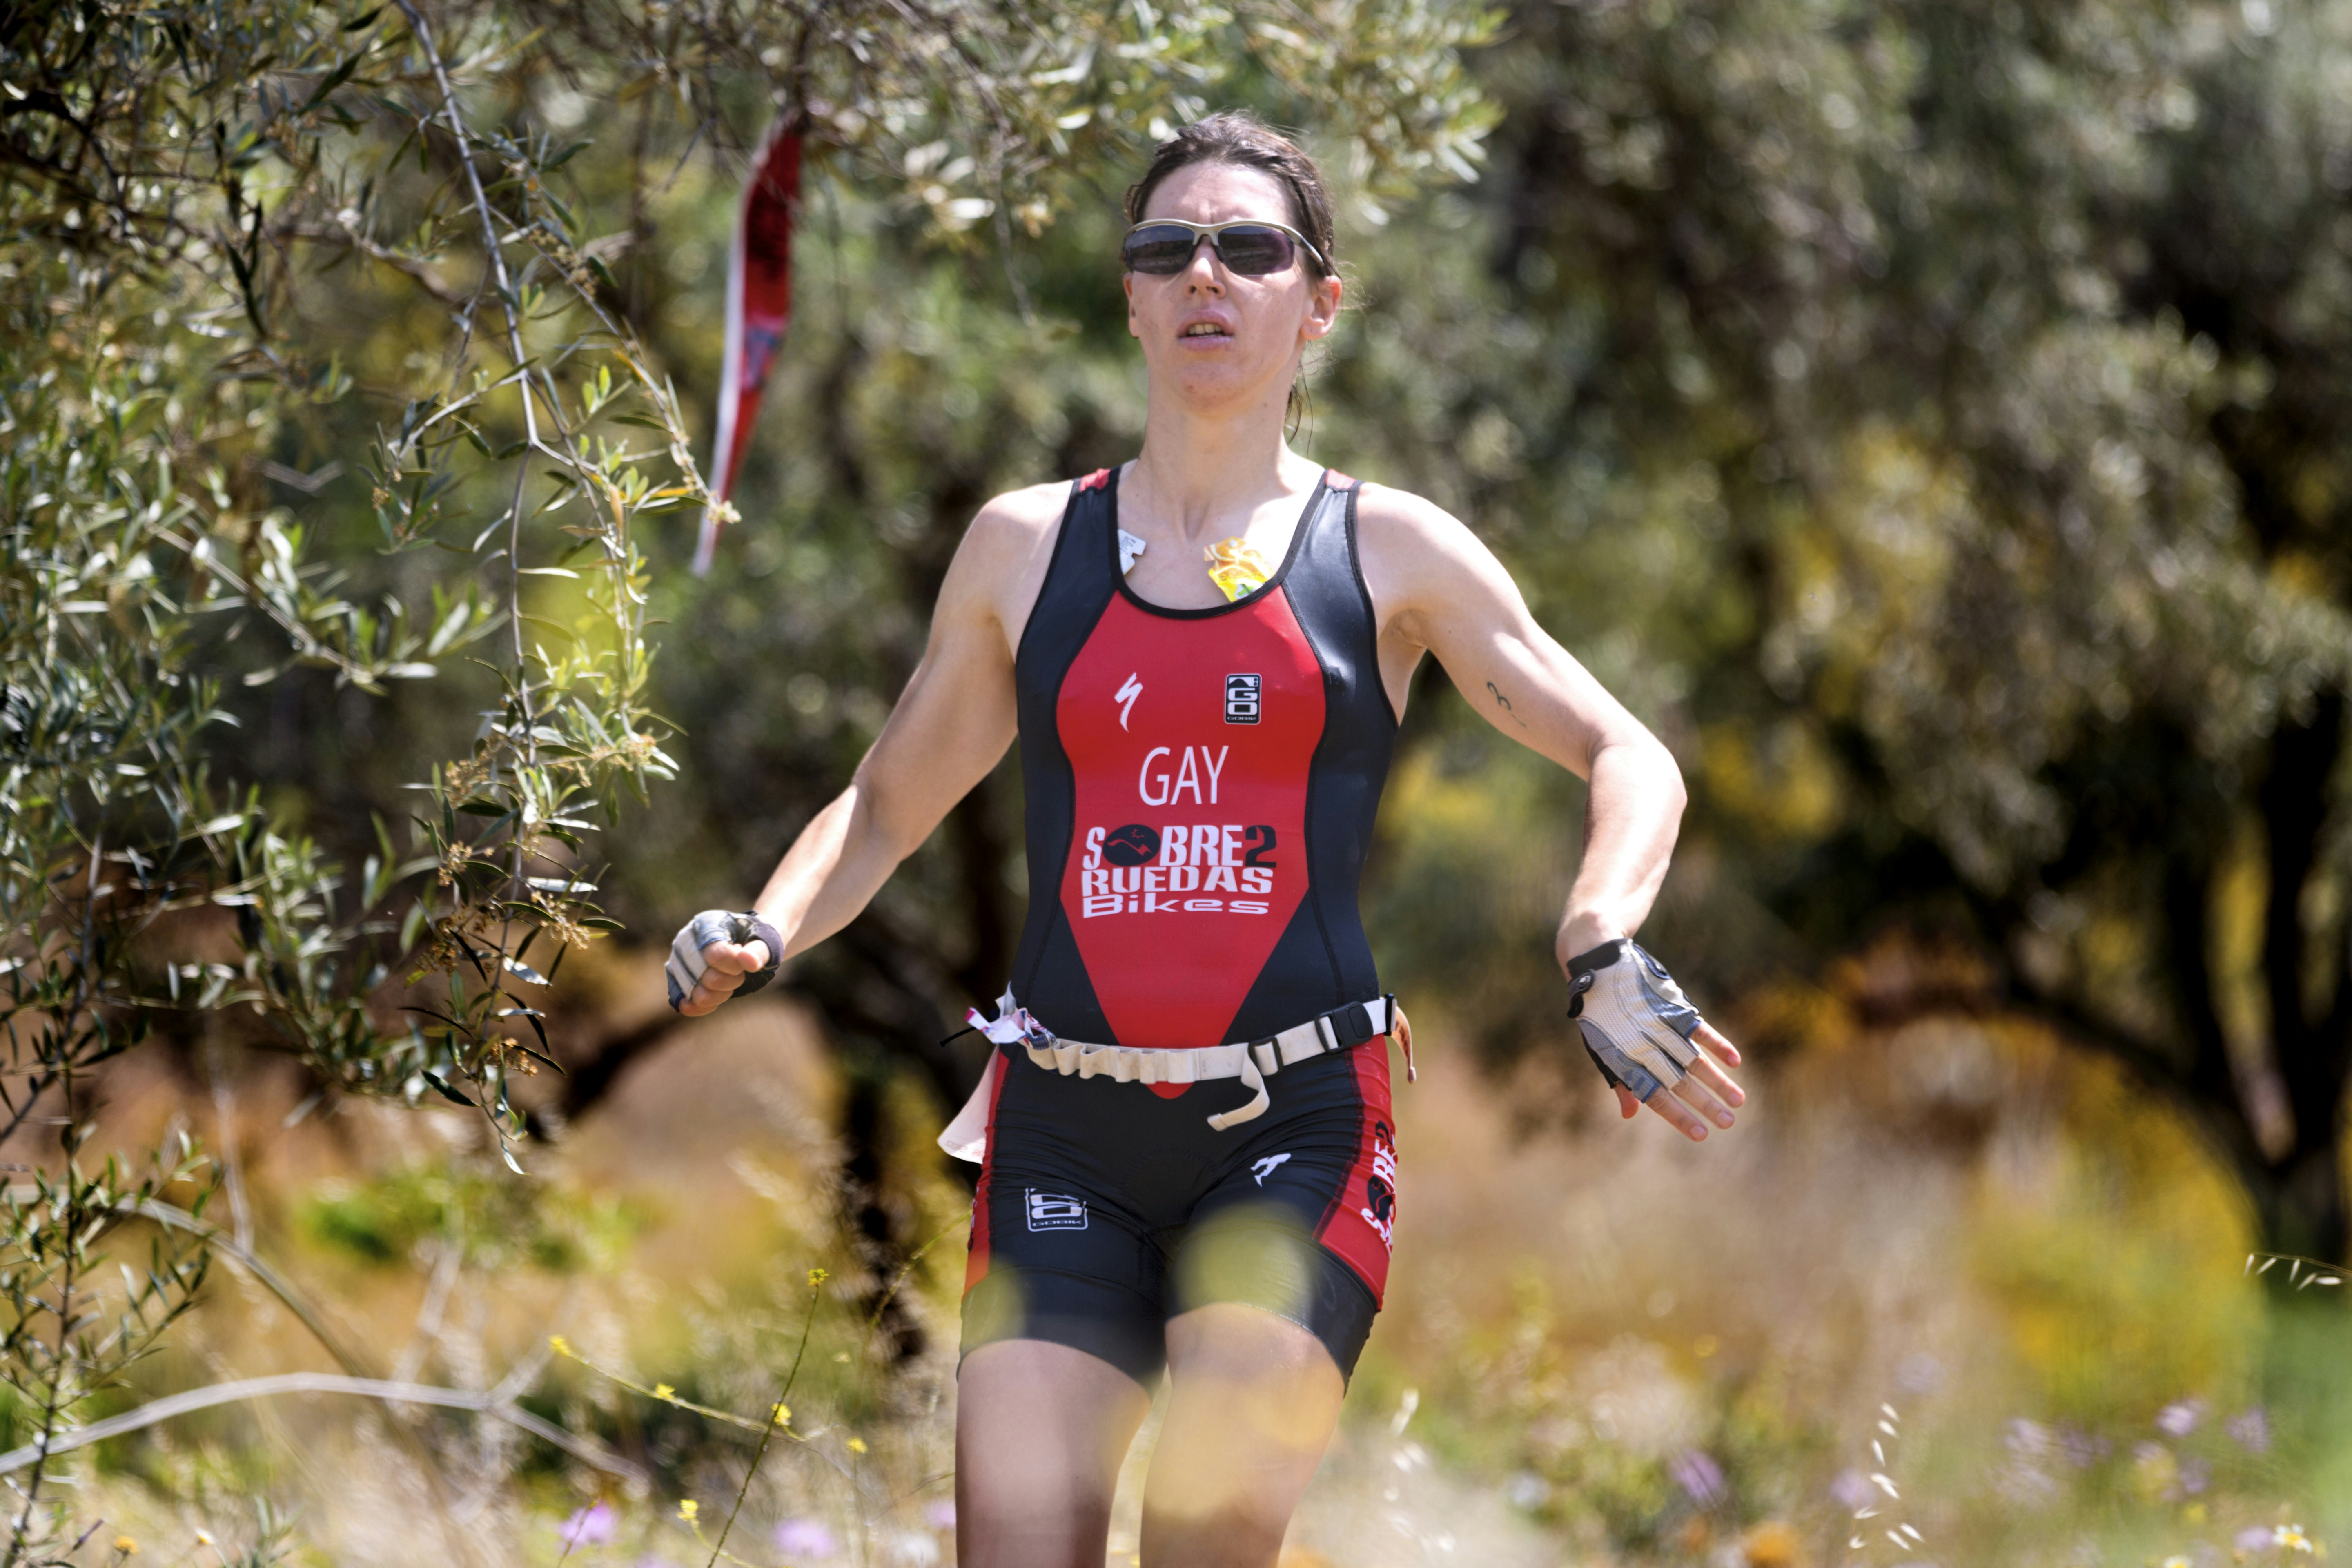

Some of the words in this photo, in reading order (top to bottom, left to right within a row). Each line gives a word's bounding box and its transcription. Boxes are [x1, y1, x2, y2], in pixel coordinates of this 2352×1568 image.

[1139, 746, 1229, 806] GAY
[1082, 866, 1274, 897] RUEDAS
[1083, 893, 1270, 918] Bikes
